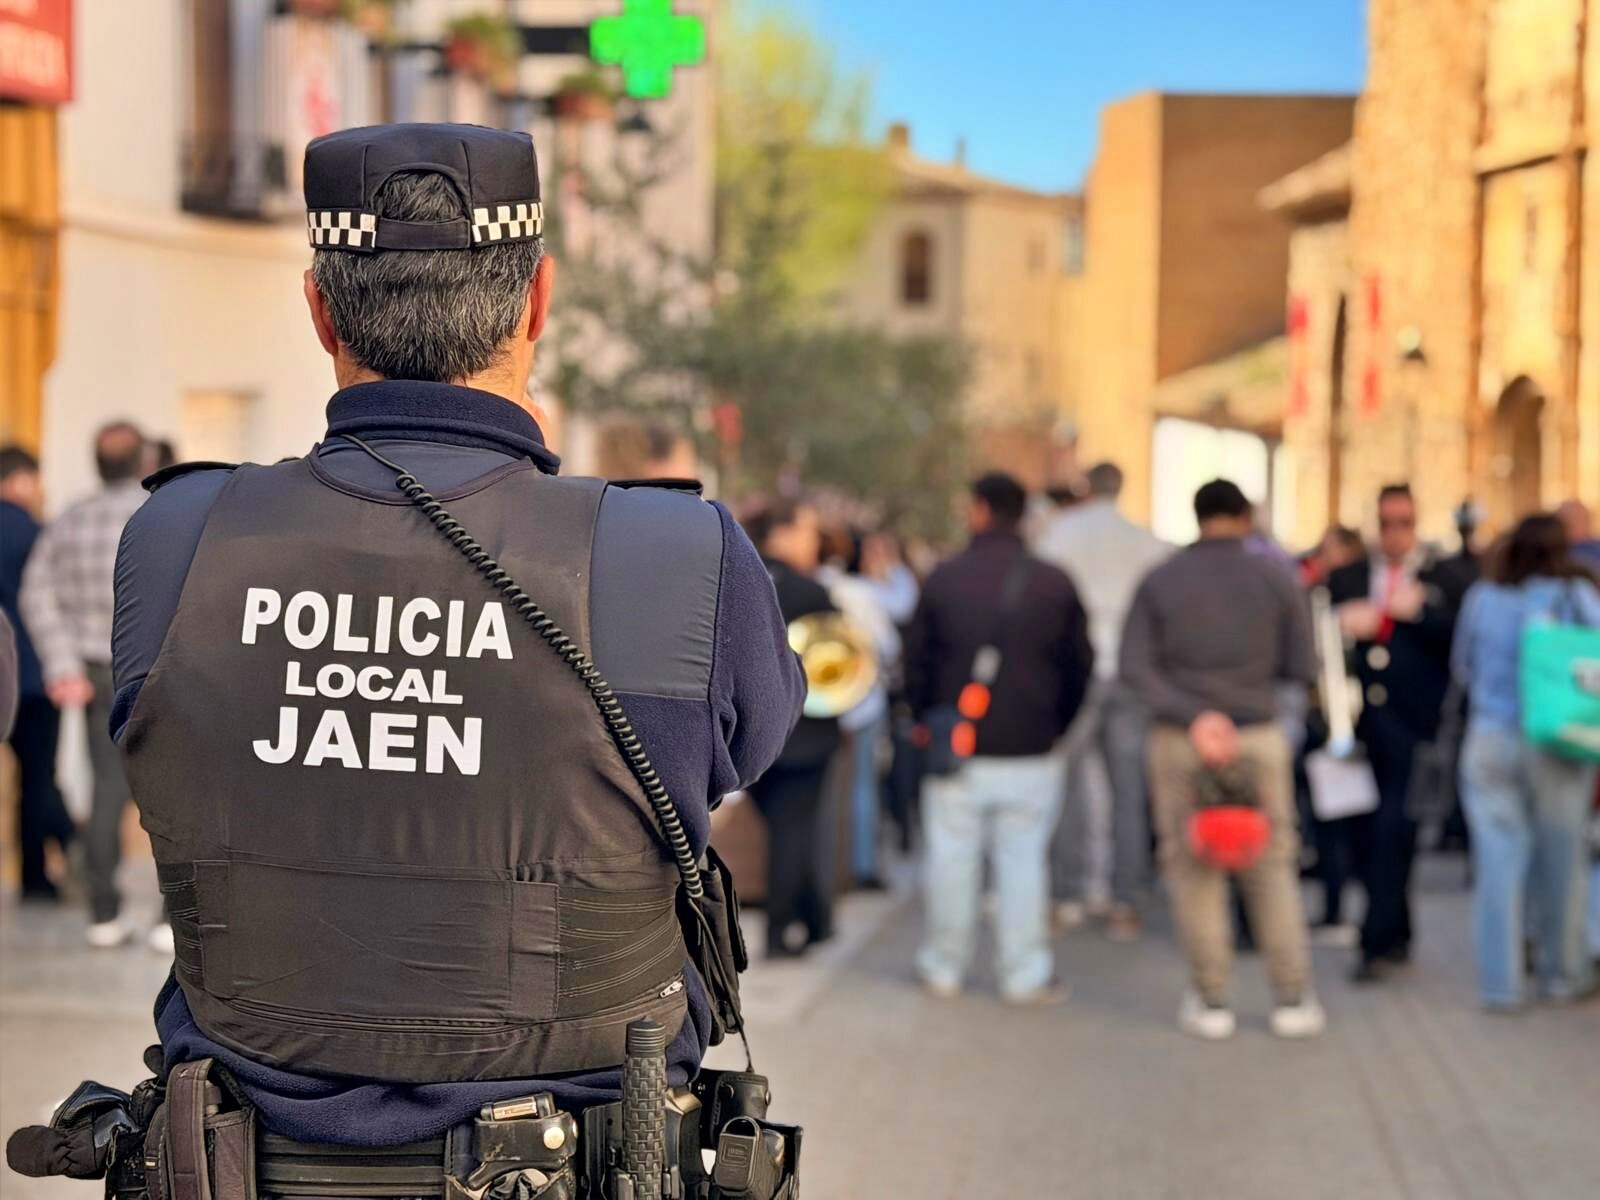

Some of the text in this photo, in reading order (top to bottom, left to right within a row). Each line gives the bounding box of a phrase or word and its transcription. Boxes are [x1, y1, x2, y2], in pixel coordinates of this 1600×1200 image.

[241, 587, 513, 659] POLICIA
[285, 661, 463, 704] LOCAL
[252, 706, 482, 775] JAEN
